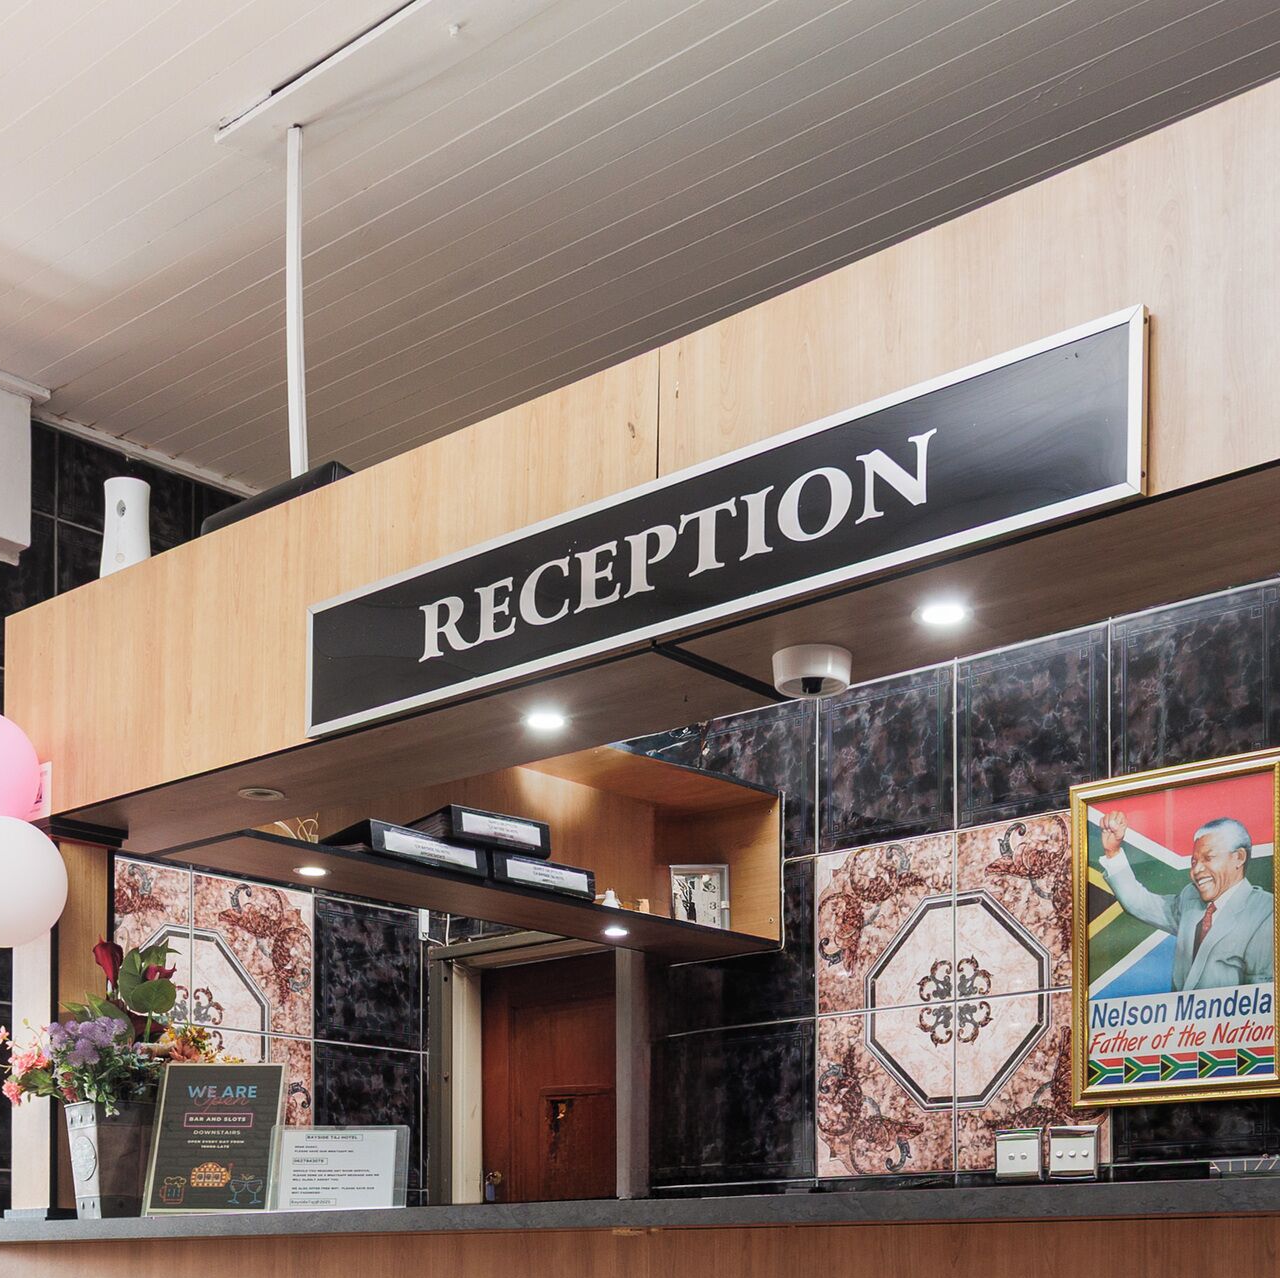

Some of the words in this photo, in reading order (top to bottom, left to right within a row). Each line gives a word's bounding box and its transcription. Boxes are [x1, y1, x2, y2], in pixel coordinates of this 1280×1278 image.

[418, 428, 937, 663] RECEPTION
[1092, 1001, 1167, 1028] Nelson
[1175, 988, 1272, 1021] Mandela
[1089, 1029, 1147, 1054] Father
[1151, 1026, 1175, 1049] of
[1178, 1024, 1205, 1047] the
[1212, 1019, 1275, 1045] Nation
[188, 1086, 217, 1098] WE
[222, 1086, 257, 1098] ARE
